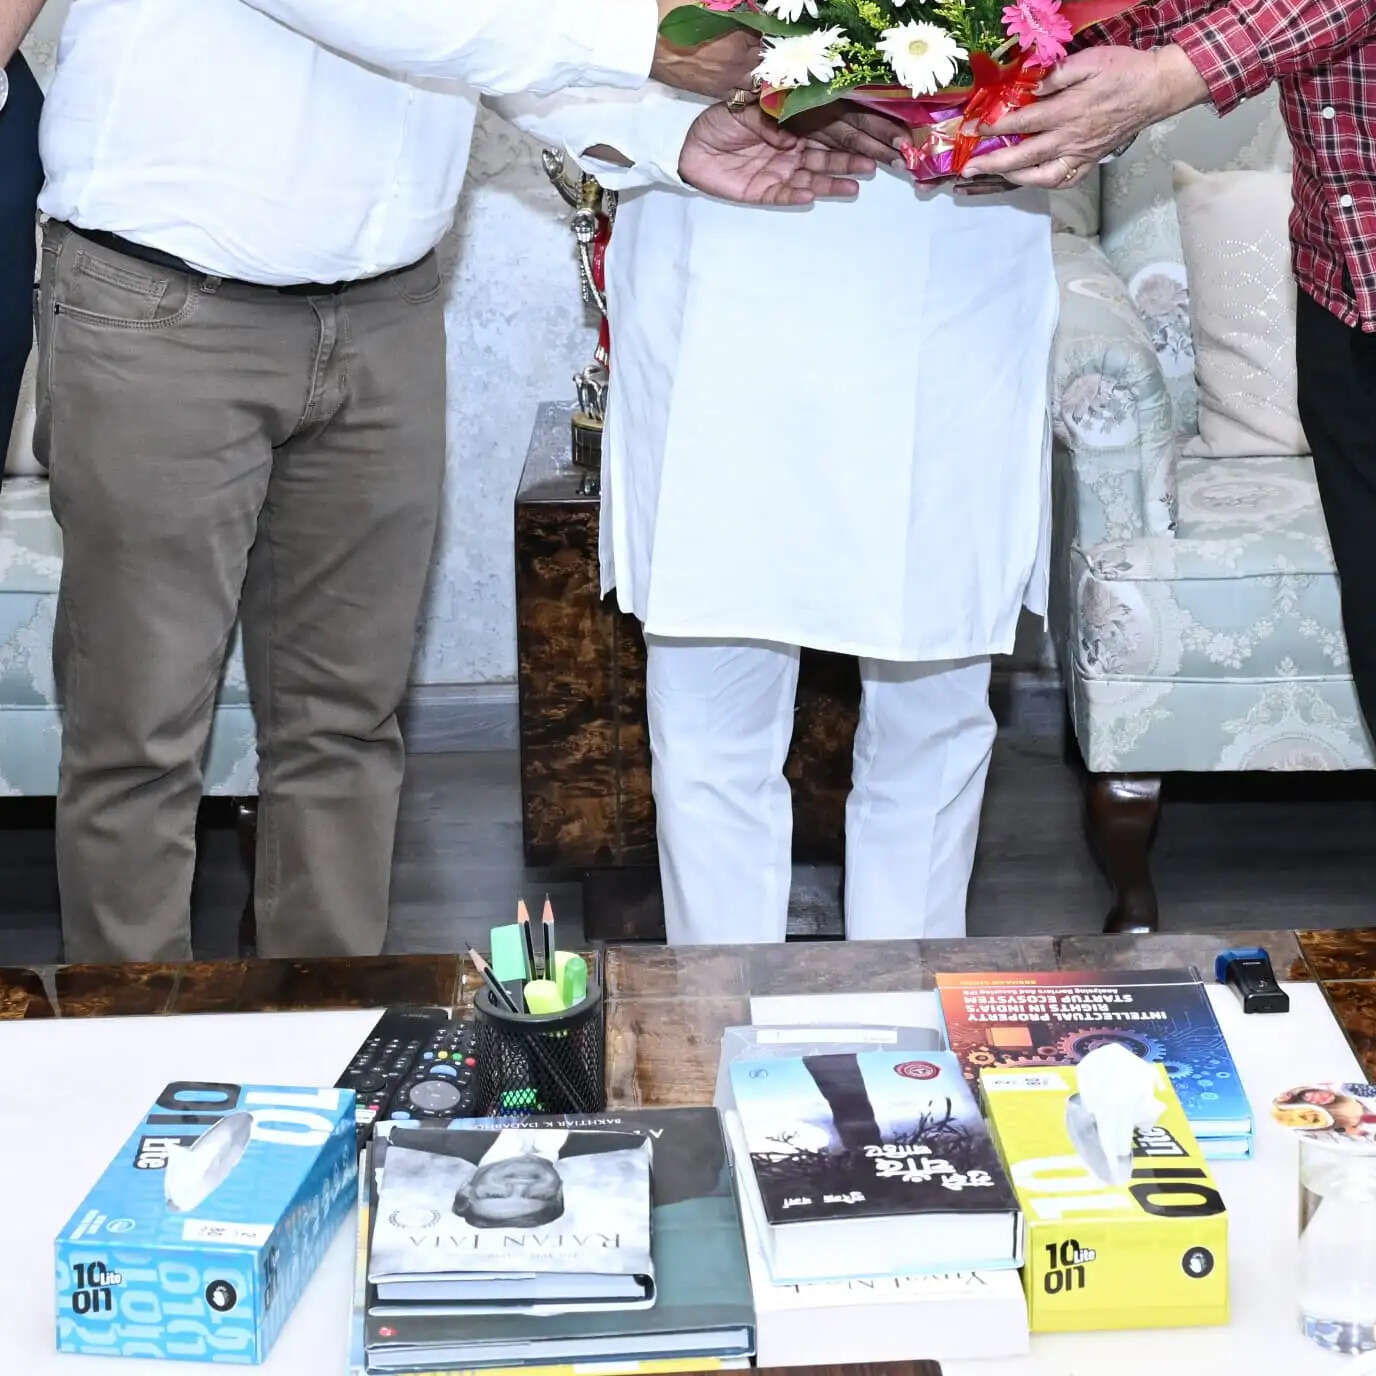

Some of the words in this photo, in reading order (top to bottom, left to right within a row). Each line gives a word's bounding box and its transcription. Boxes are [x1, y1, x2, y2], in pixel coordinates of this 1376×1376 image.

[963, 994, 1059, 1004] ECOSYSTEM
[1061, 994, 1134, 1004] STARTUP
[1028, 1003, 1046, 1013] IN
[1049, 1003, 1109, 1013] RIGHTS
[967, 1012, 1051, 1022] PROPERTY
[1051, 1011, 1168, 1022] INTELLECTUAL
[1045, 1239, 1081, 1269] 10
[72, 1261, 107, 1289] 10
